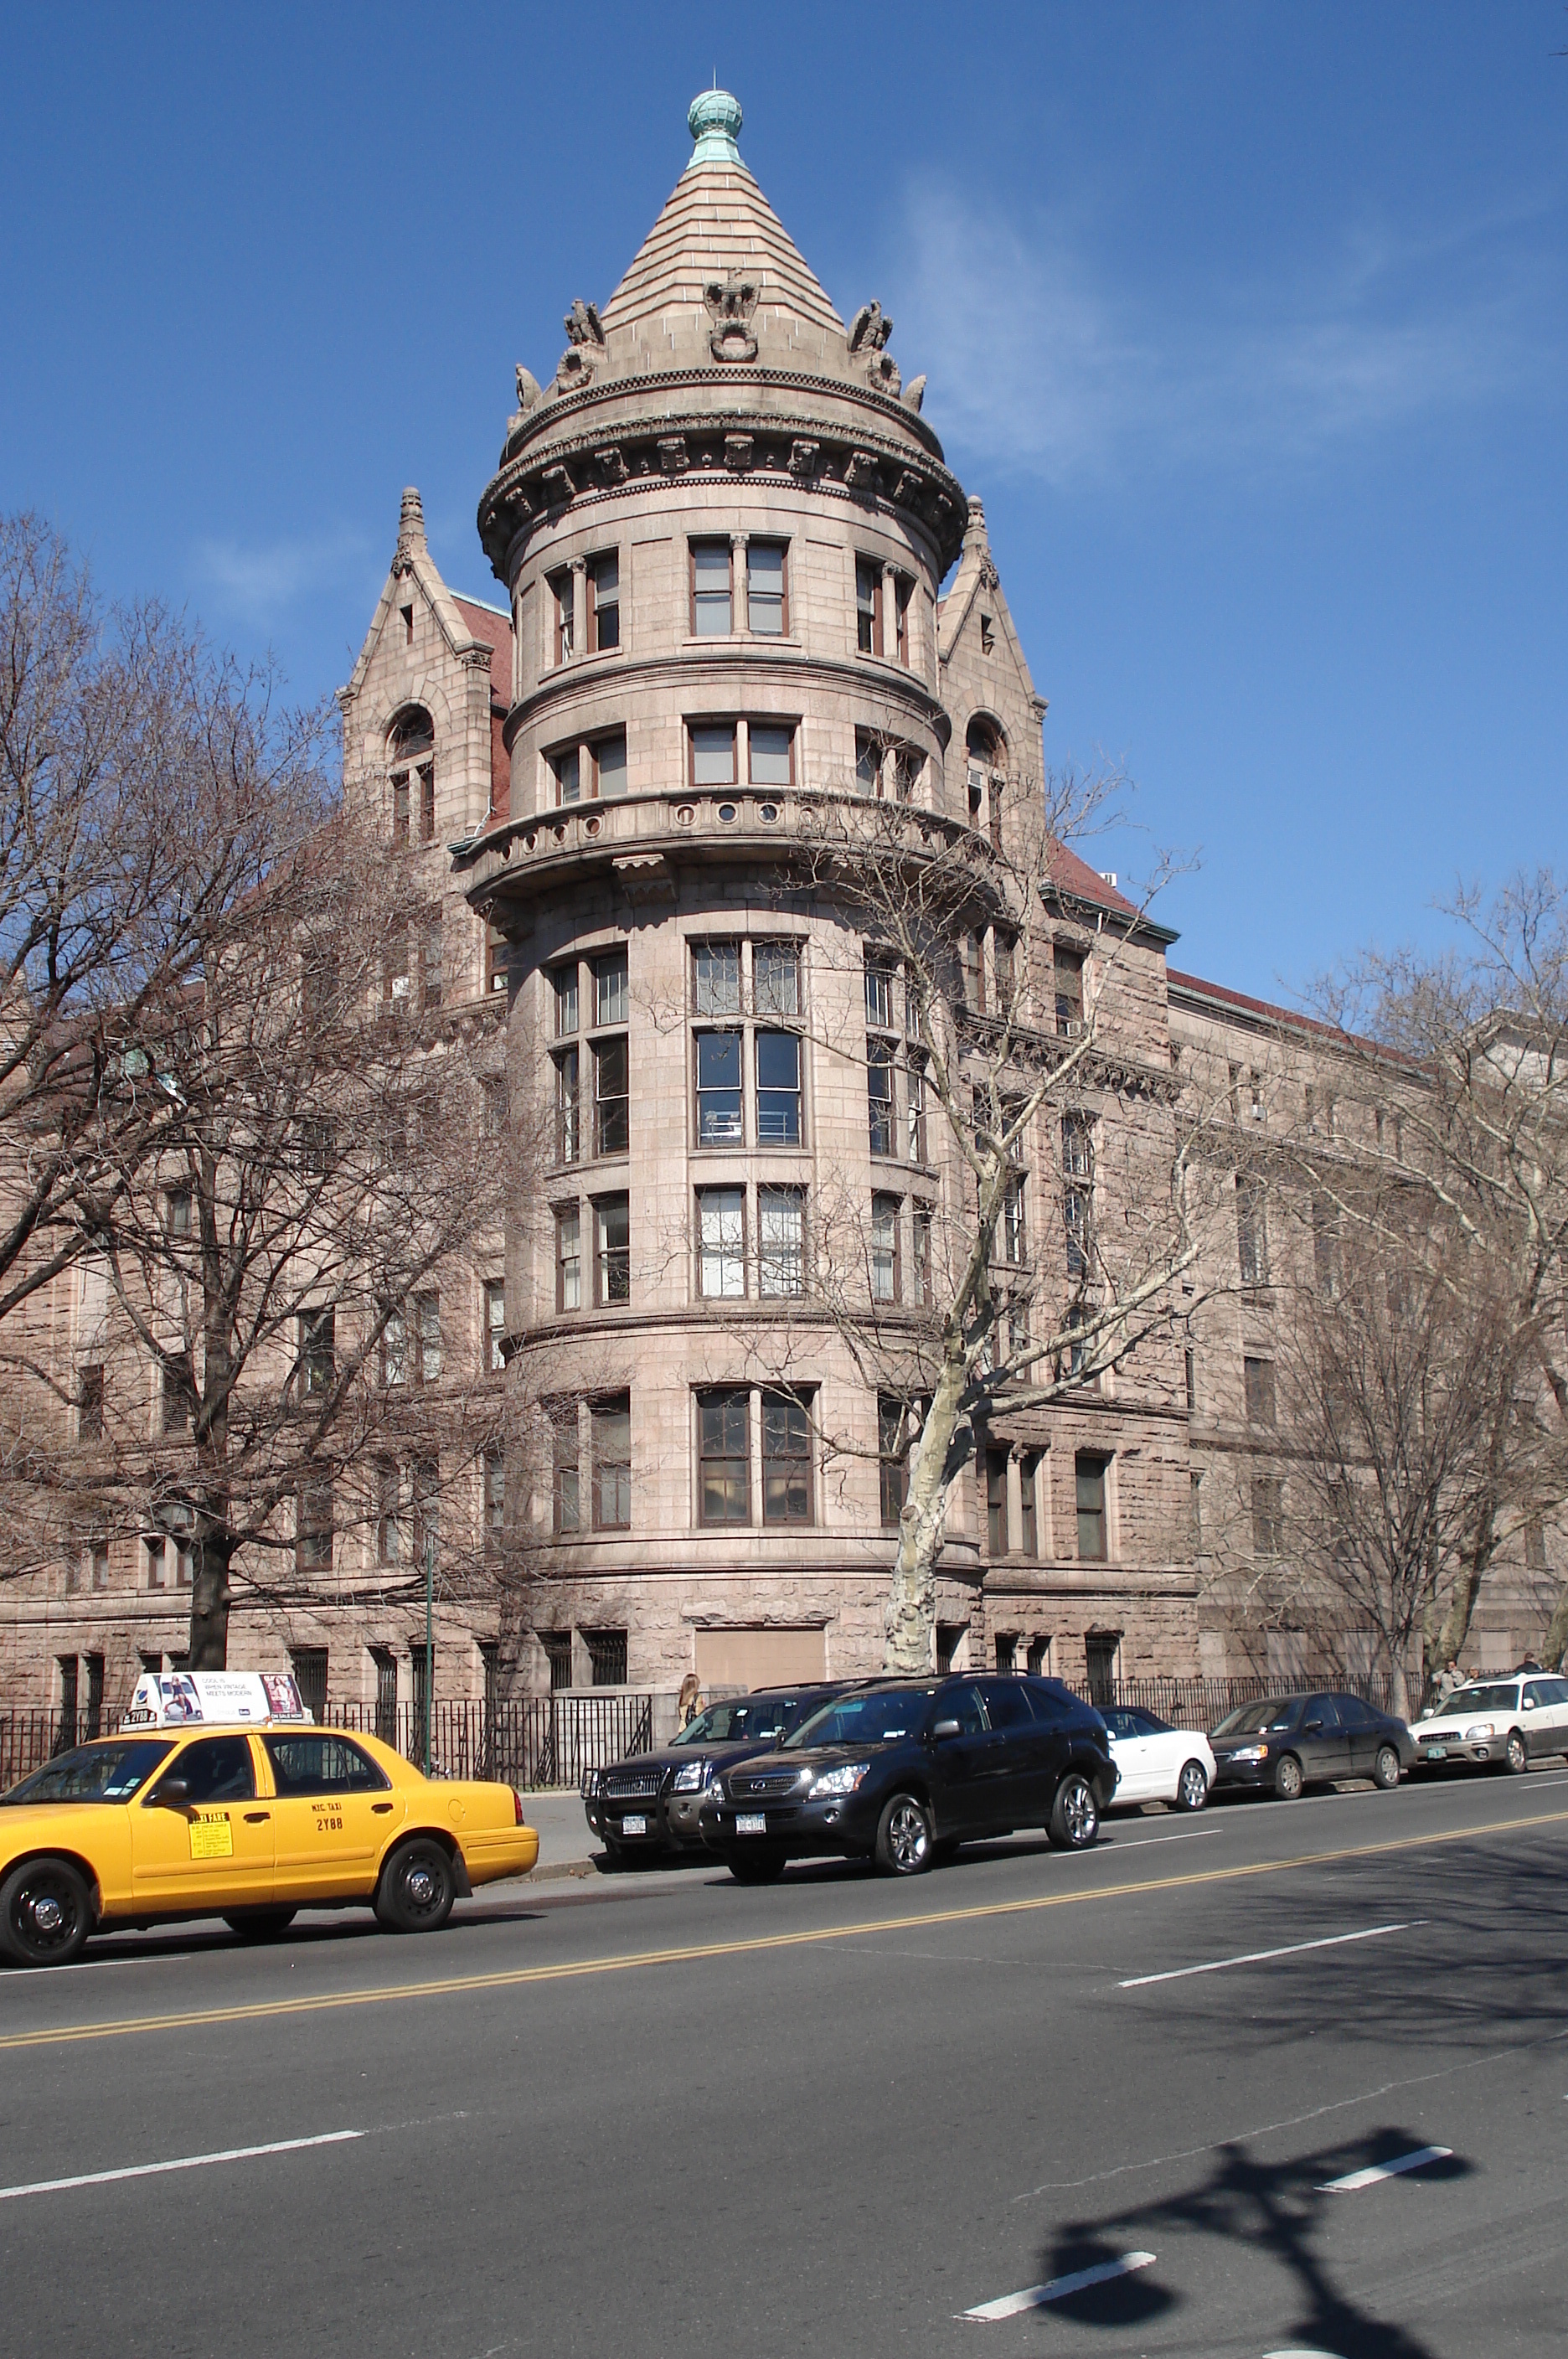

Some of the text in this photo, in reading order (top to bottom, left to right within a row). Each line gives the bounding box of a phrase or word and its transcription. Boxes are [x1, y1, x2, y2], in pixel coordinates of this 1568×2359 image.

[131, 1710, 148, 1722] 2Y88
[327, 1802, 342, 1810] TAXI
[209, 1812, 225, 1823] FARE
[317, 1817, 343, 1830] 2Y88
